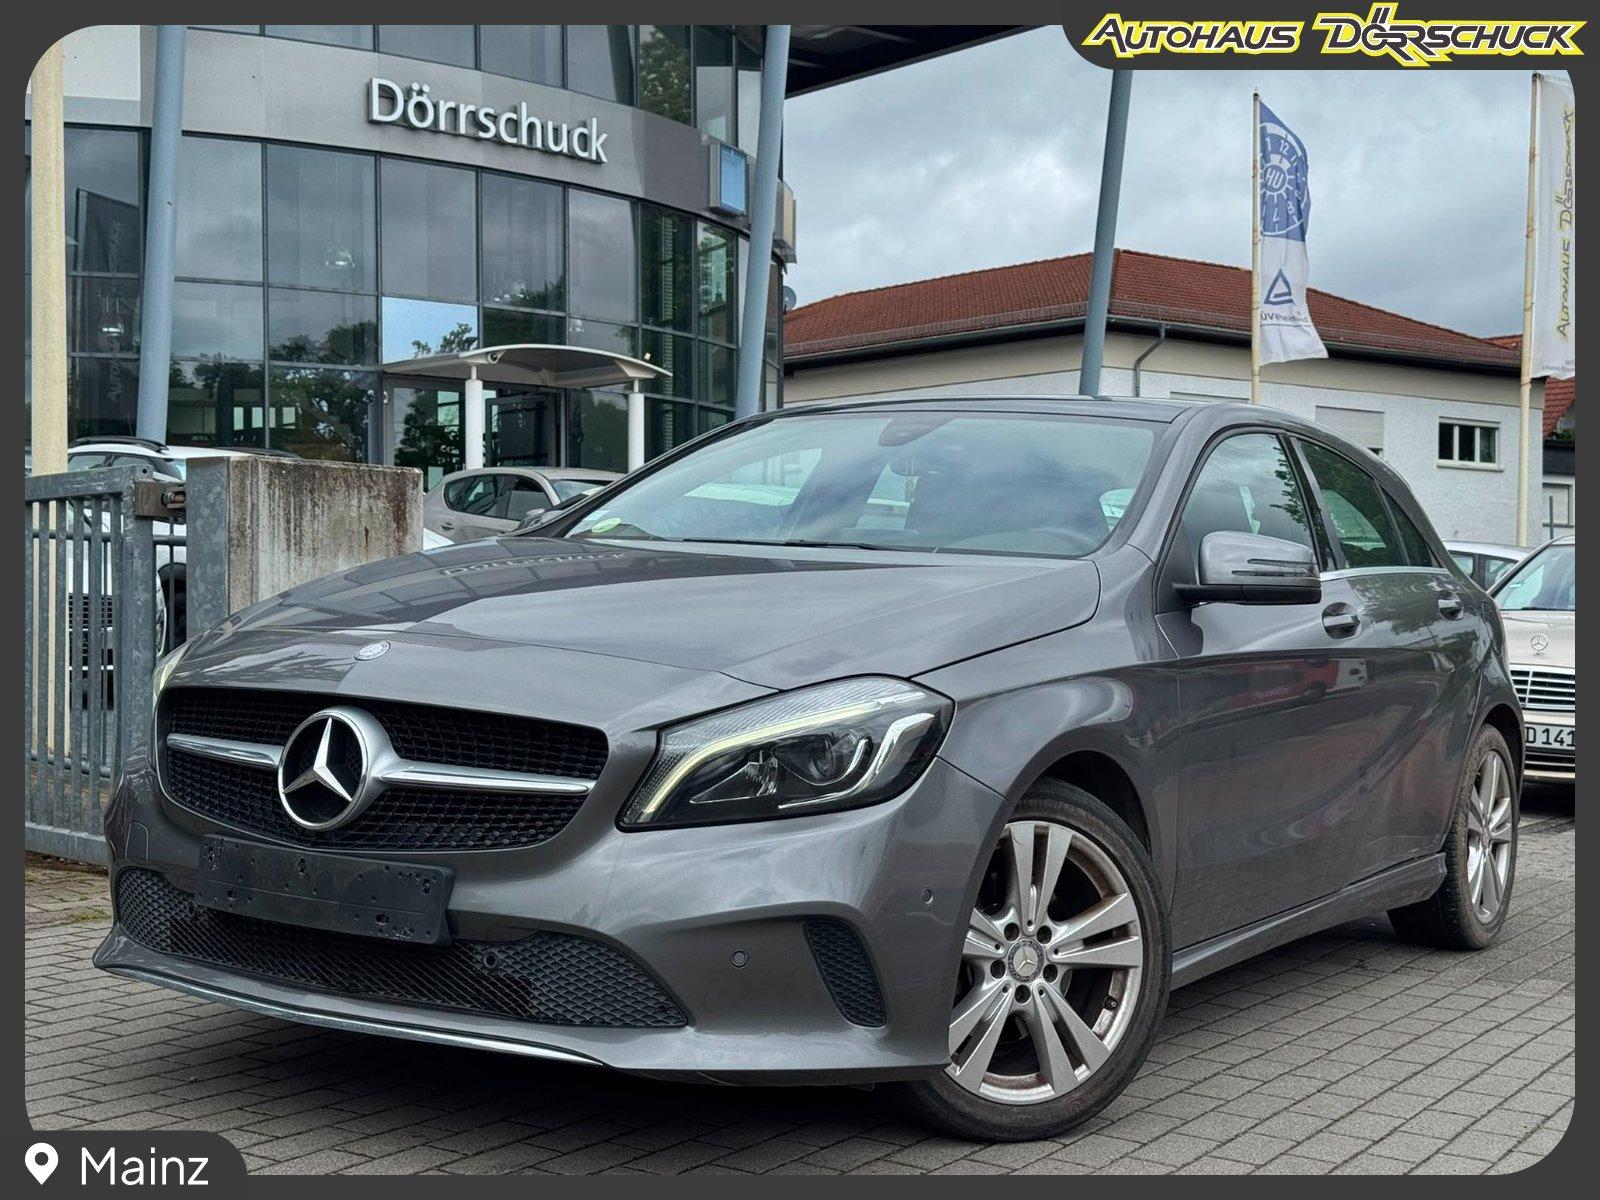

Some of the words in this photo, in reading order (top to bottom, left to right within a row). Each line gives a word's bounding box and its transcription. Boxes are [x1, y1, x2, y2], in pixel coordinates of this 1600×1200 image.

[369, 77, 608, 163] Dörrschuck
[1279, 139, 1290, 155] 12
[1265, 167, 1285, 189] HU
